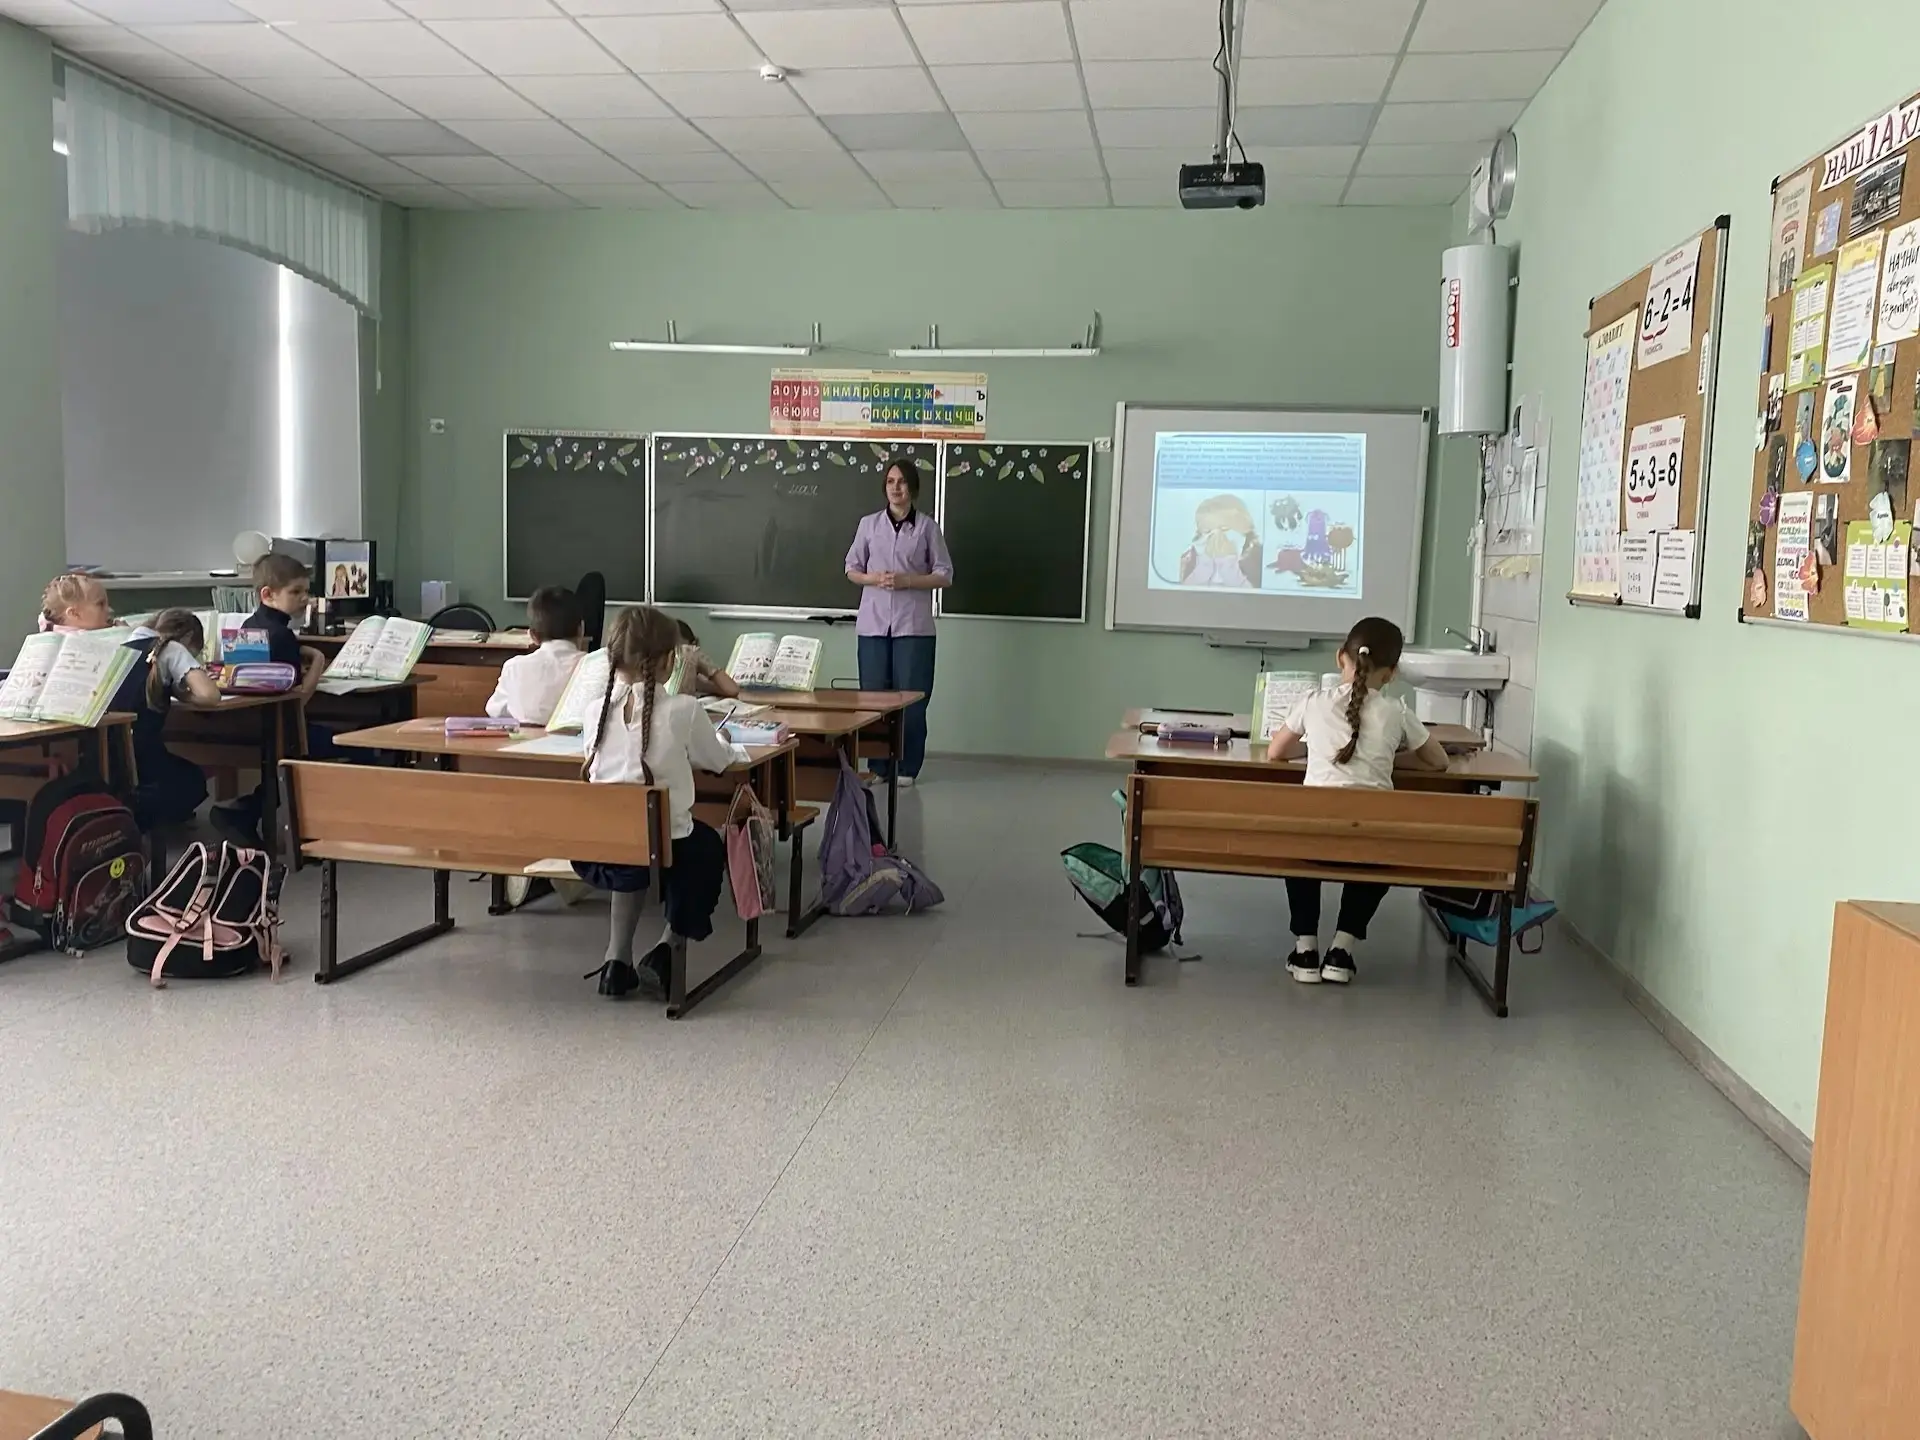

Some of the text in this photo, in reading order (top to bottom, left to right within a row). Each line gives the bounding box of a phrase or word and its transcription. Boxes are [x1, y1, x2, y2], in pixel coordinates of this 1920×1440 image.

[1823, 139, 1865, 185] НАШ
[1866, 113, 1893, 164] 1А
[1888, 245, 1920, 273] НАЧНИ
[1629, 452, 1677, 491] 5+3=8
